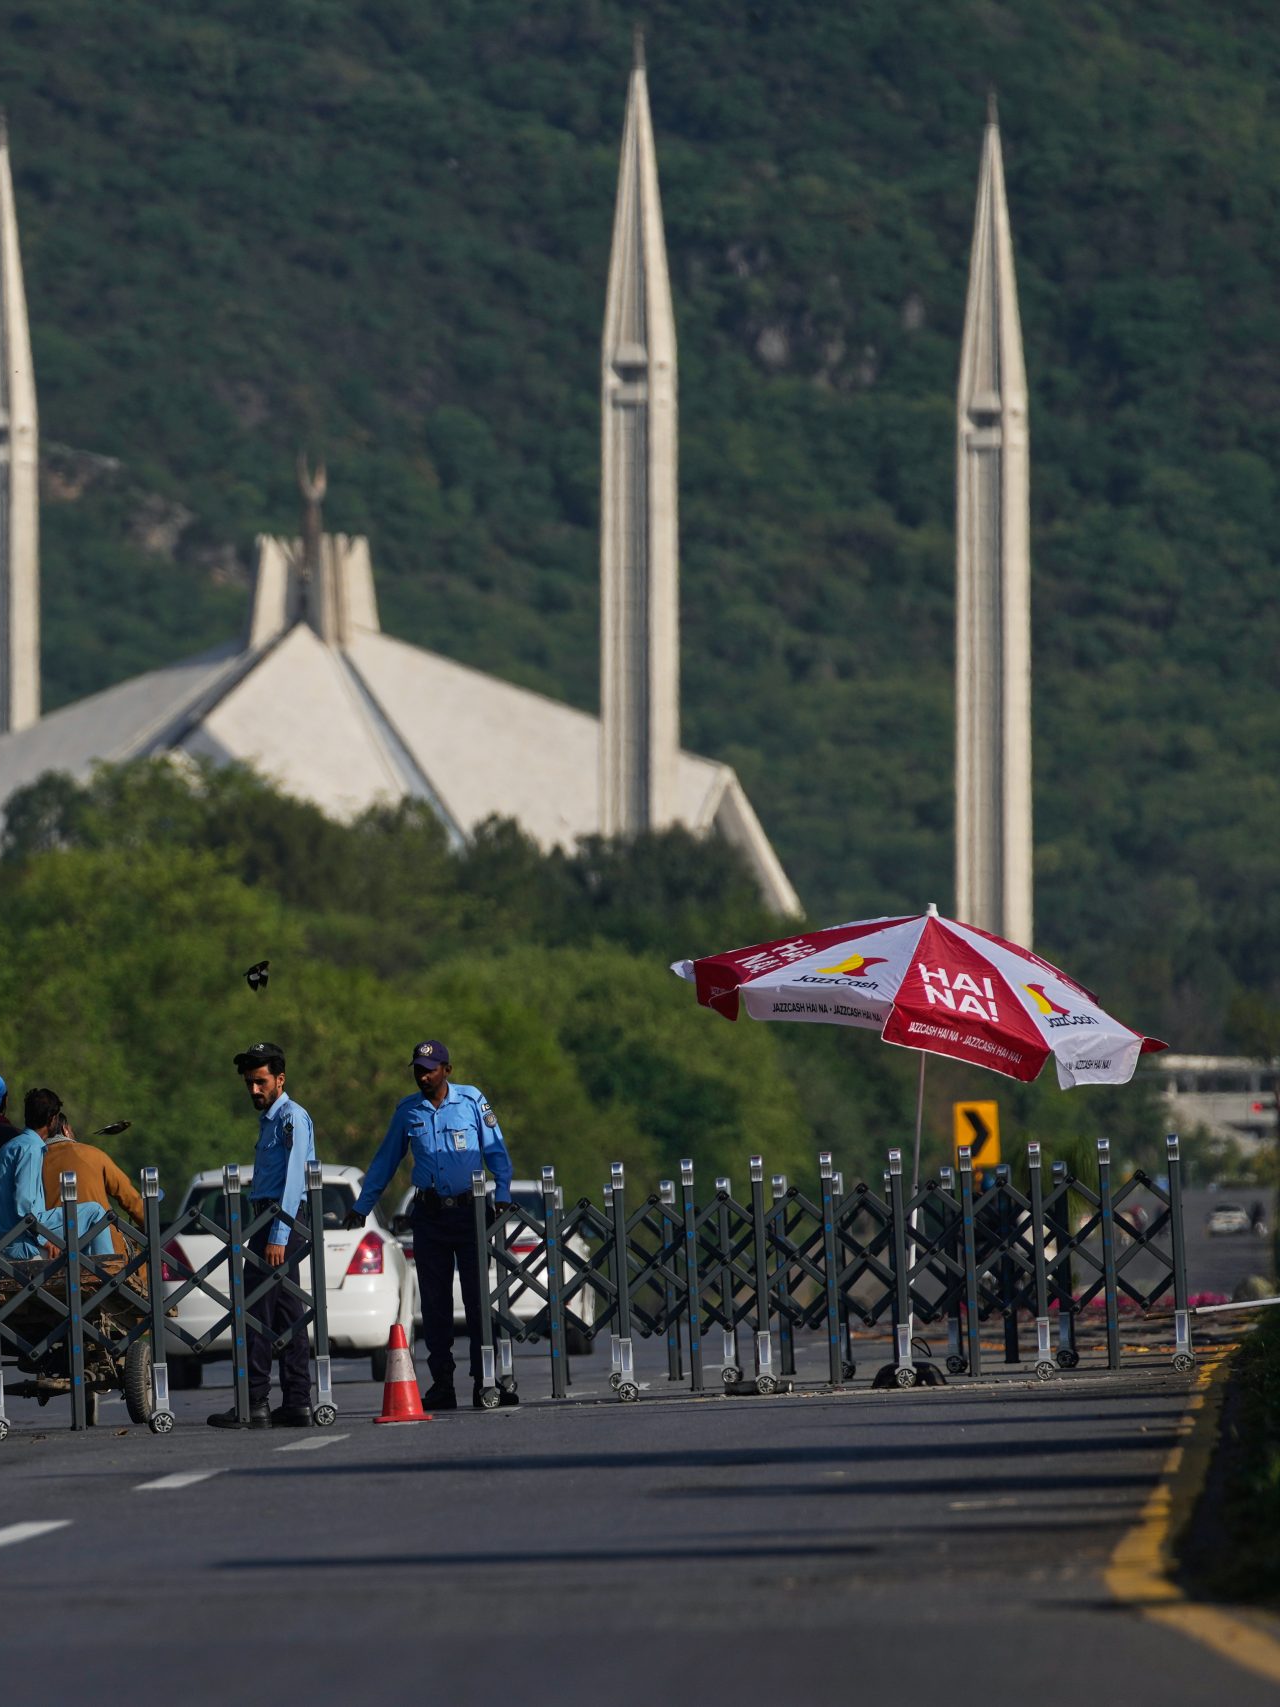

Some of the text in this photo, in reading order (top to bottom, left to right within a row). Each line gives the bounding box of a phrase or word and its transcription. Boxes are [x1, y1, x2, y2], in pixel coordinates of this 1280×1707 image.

[792, 974, 880, 991] JazzCash
[918, 962, 995, 999] HAI
[772, 1002, 806, 1014] JAZZCASH
[806, 1002, 818, 1014] HAI
[818, 1004, 829, 1015] NA
[833, 1004, 862, 1018] JAZZCASH
[923, 983, 1000, 1023] NA!
[1043, 1013, 1100, 1028] JazzCash
[907, 1021, 938, 1036] JAZZCASH
[937, 1027, 950, 1039] HAI
[949, 1030, 960, 1042] NA
[963, 1034, 997, 1056] JAZZCASH
